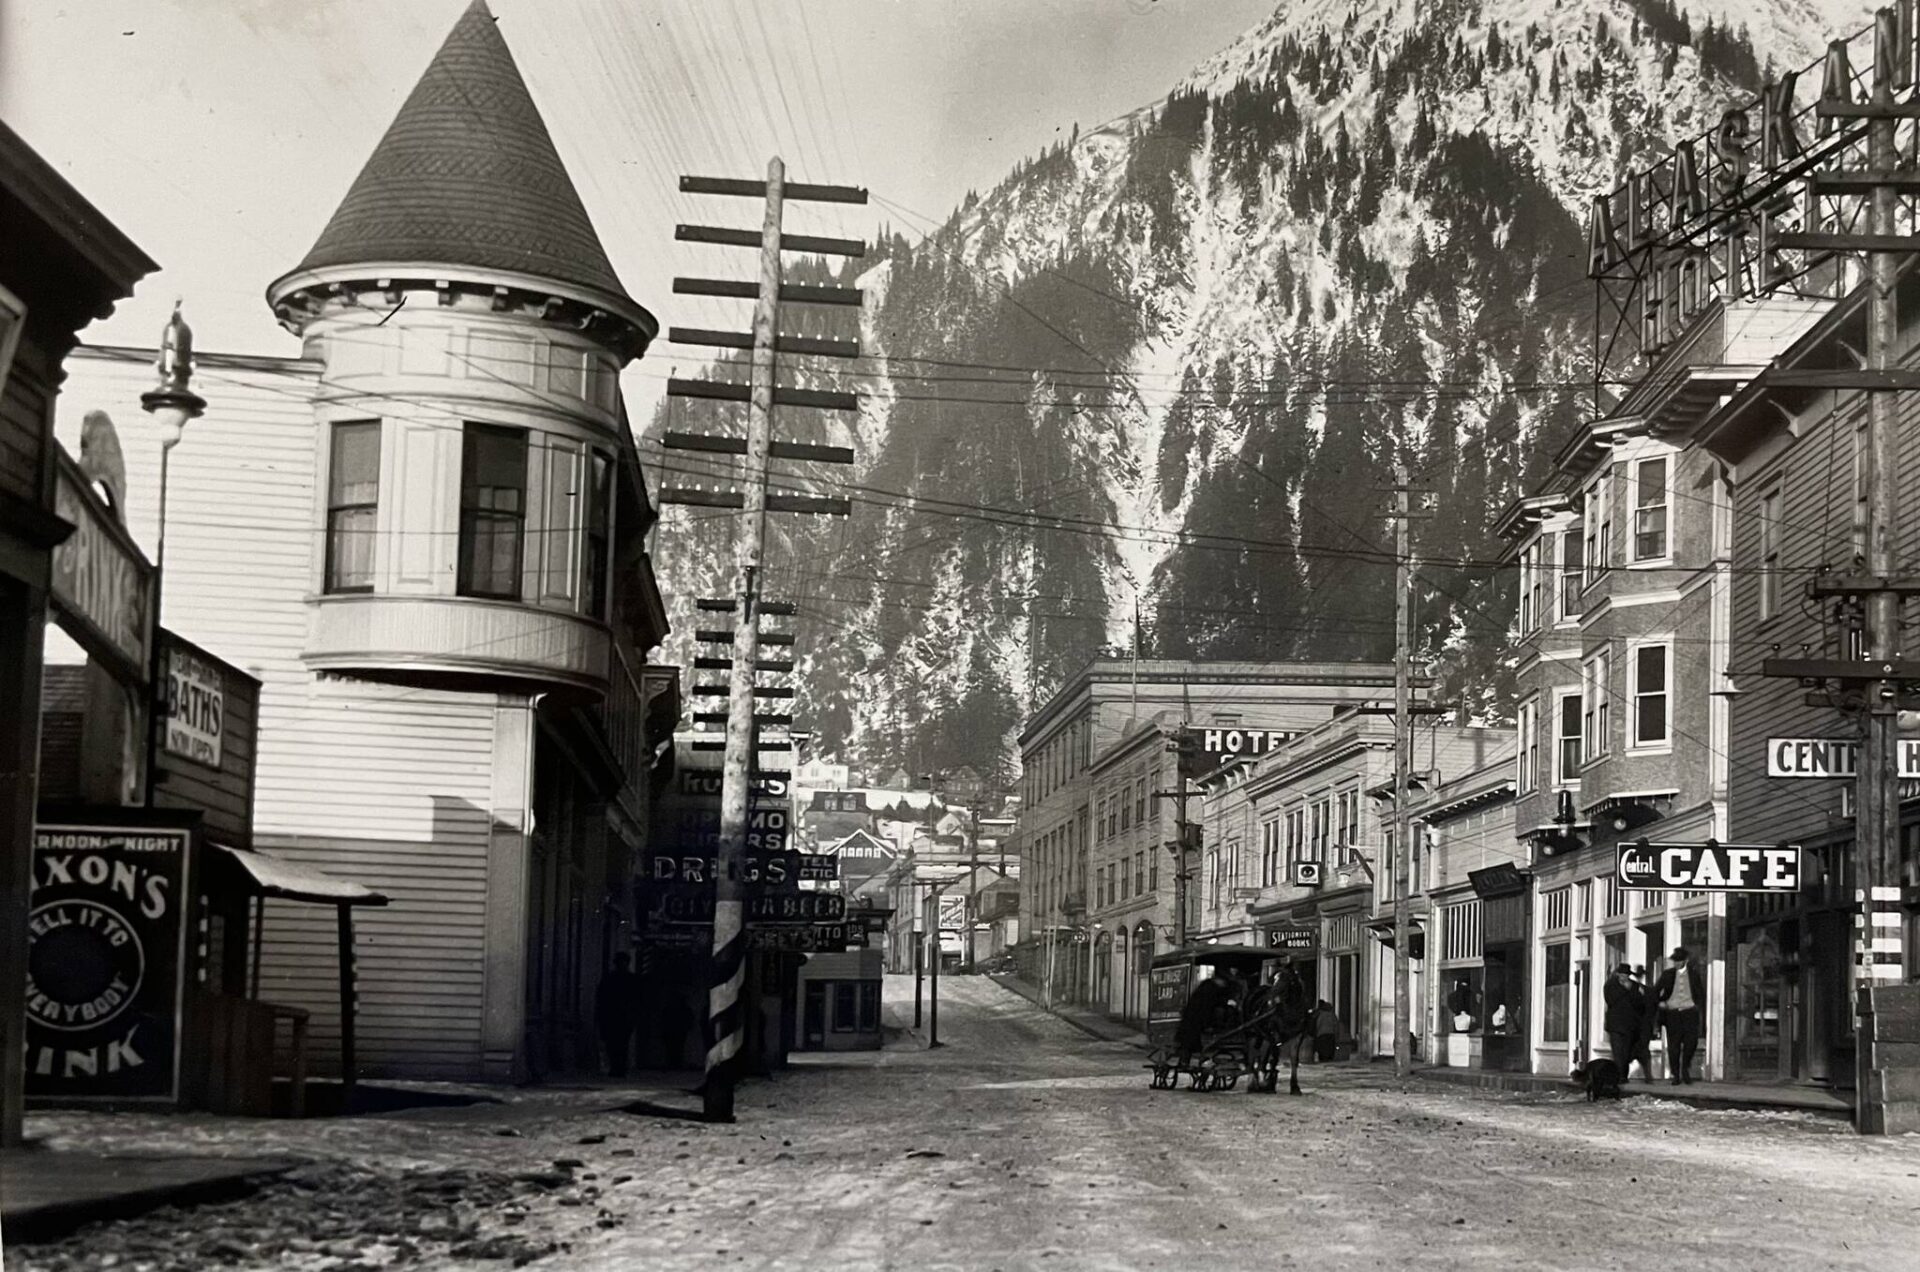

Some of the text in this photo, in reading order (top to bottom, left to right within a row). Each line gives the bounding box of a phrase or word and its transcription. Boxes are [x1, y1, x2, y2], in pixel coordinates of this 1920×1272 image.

[169, 674, 221, 736] BATHS
[125, 837, 180, 852] NIGHT
[653, 856, 787, 883] DRGS
[1660, 848, 1797, 887] CAFE
[30, 855, 170, 920] XON'S
[79, 908, 103, 930] IT
[102, 919, 129, 947] TO
[1272, 931, 1310, 945] STATIONERY
[1287, 939, 1310, 947] BOOKS
[26, 1024, 144, 1078] INK
